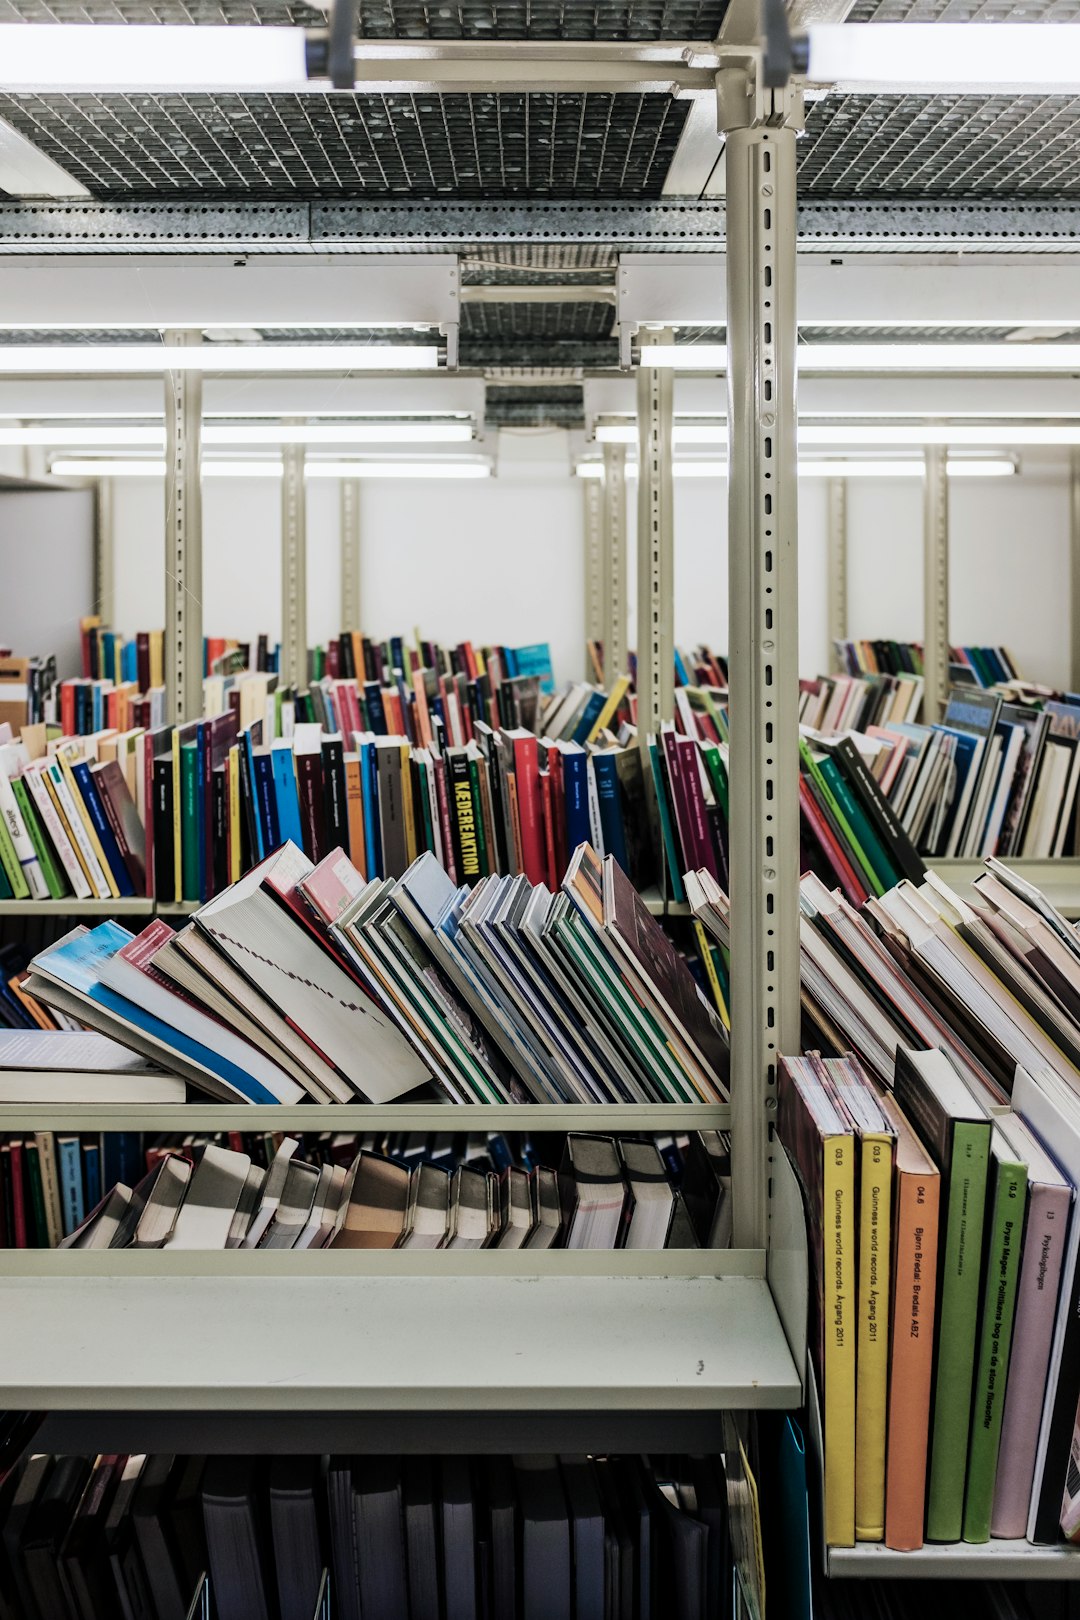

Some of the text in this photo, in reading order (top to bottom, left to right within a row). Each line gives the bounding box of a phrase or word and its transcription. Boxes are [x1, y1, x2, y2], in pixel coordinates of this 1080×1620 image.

[454, 781, 479, 875] KÆDEREAKTION
[871, 1186, 880, 1226] Guinness
[834, 1148, 845, 1347] 03.9 Guinness world records. Årgang 2011
[871, 1228, 879, 1251] world
[910, 1186, 925, 1338] 04.6 Bjørn Bredal: Bredals ABZ
[1037, 1211, 1055, 1290] 13 Psykologibogen
[870, 1253, 878, 1288] records.
[868, 1290, 879, 1321] Årgang
[869, 1323, 877, 1342] 2011
[983, 1182, 1018, 1429] 10.9 Bryan Magee: Politikens bog om de store filosoffer
